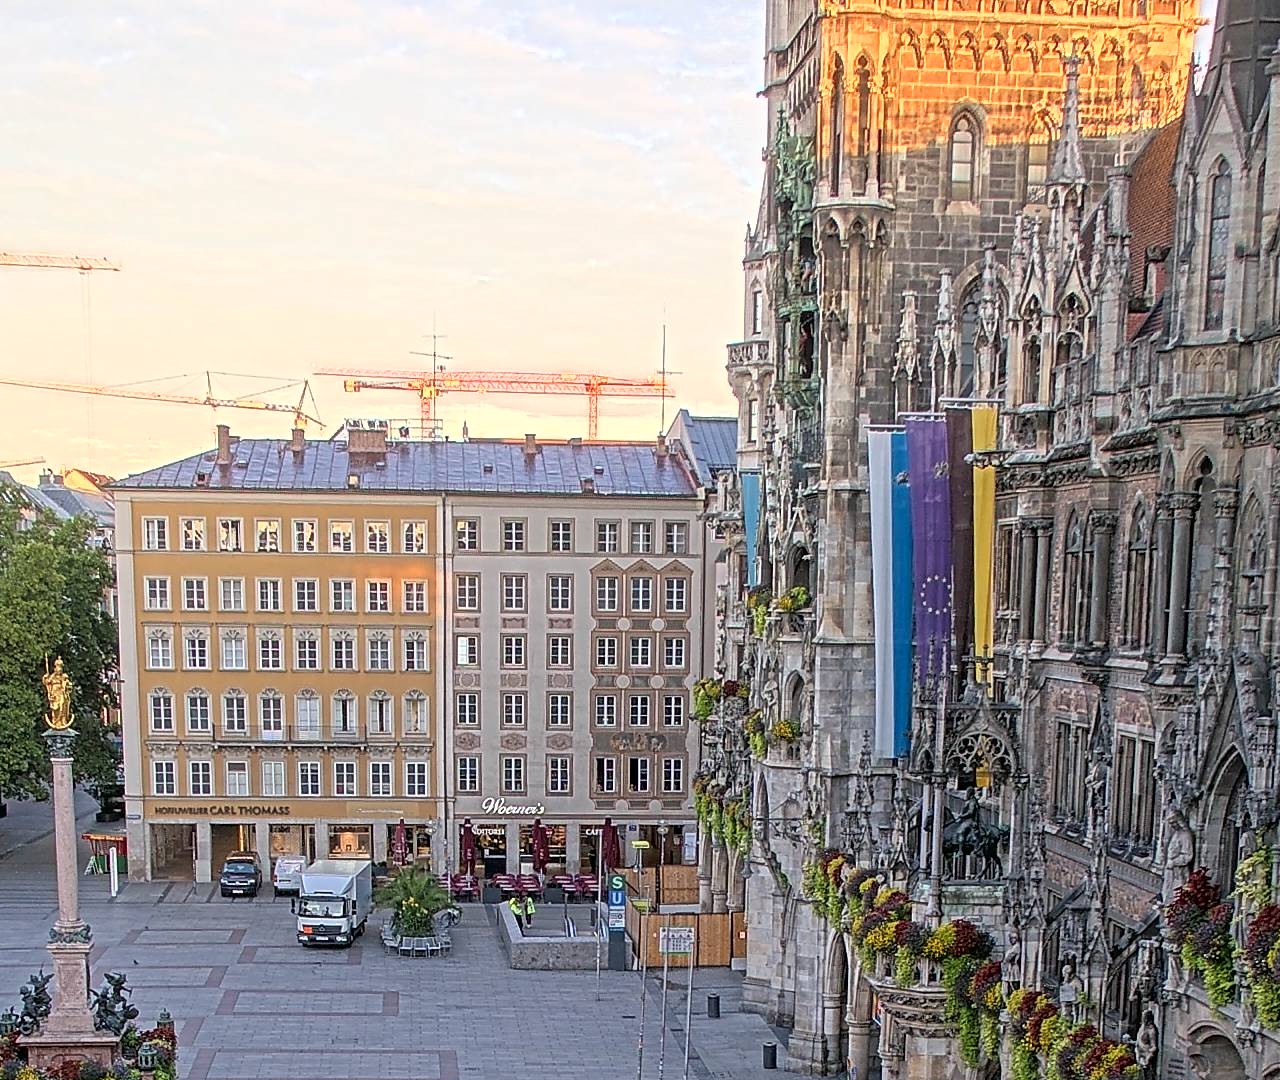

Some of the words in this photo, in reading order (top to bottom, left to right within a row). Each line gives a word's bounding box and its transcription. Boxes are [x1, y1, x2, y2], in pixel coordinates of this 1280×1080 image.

[209, 805, 236, 816] CARL
[237, 805, 291, 816] THOMASS
[481, 797, 545, 815] Woerner's
[612, 876, 623, 889] S
[612, 893, 622, 904] U
